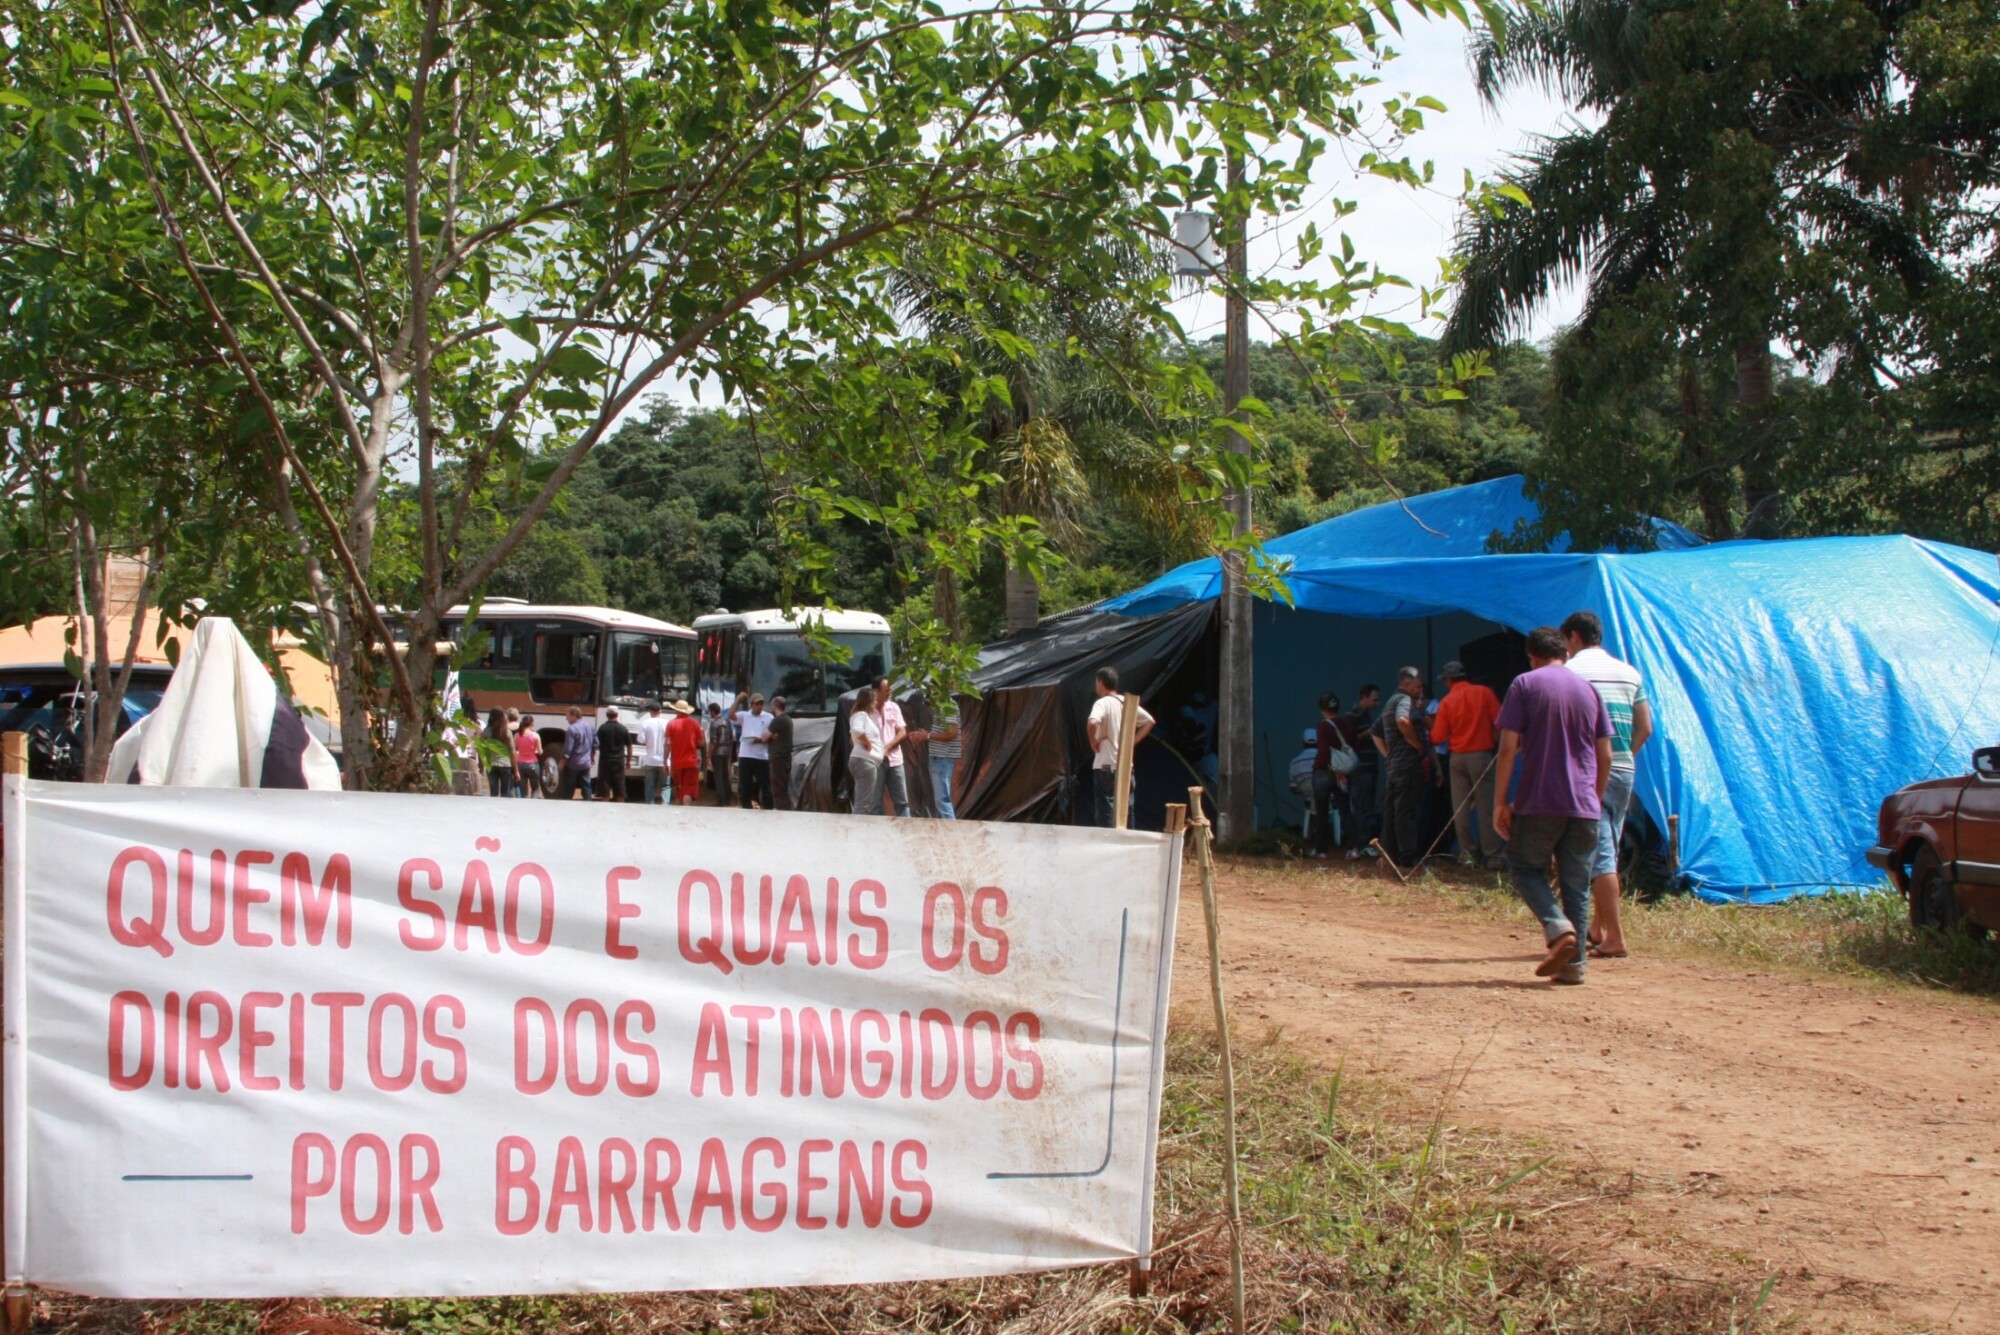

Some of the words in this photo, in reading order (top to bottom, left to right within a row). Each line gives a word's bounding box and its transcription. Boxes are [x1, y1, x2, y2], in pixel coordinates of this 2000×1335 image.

[108, 847, 351, 957] QUEM
[399, 837, 554, 954] SÃO
[606, 867, 640, 959] E
[679, 870, 888, 974] QUAIS
[923, 882, 1010, 975] OS
[109, 990, 466, 1093] DIREITOS
[515, 997, 659, 1097] DOS
[693, 1004, 1044, 1100] ATINGIDOS
[292, 1133, 443, 1234] POR
[496, 1136, 932, 1235] BARRAGENS
